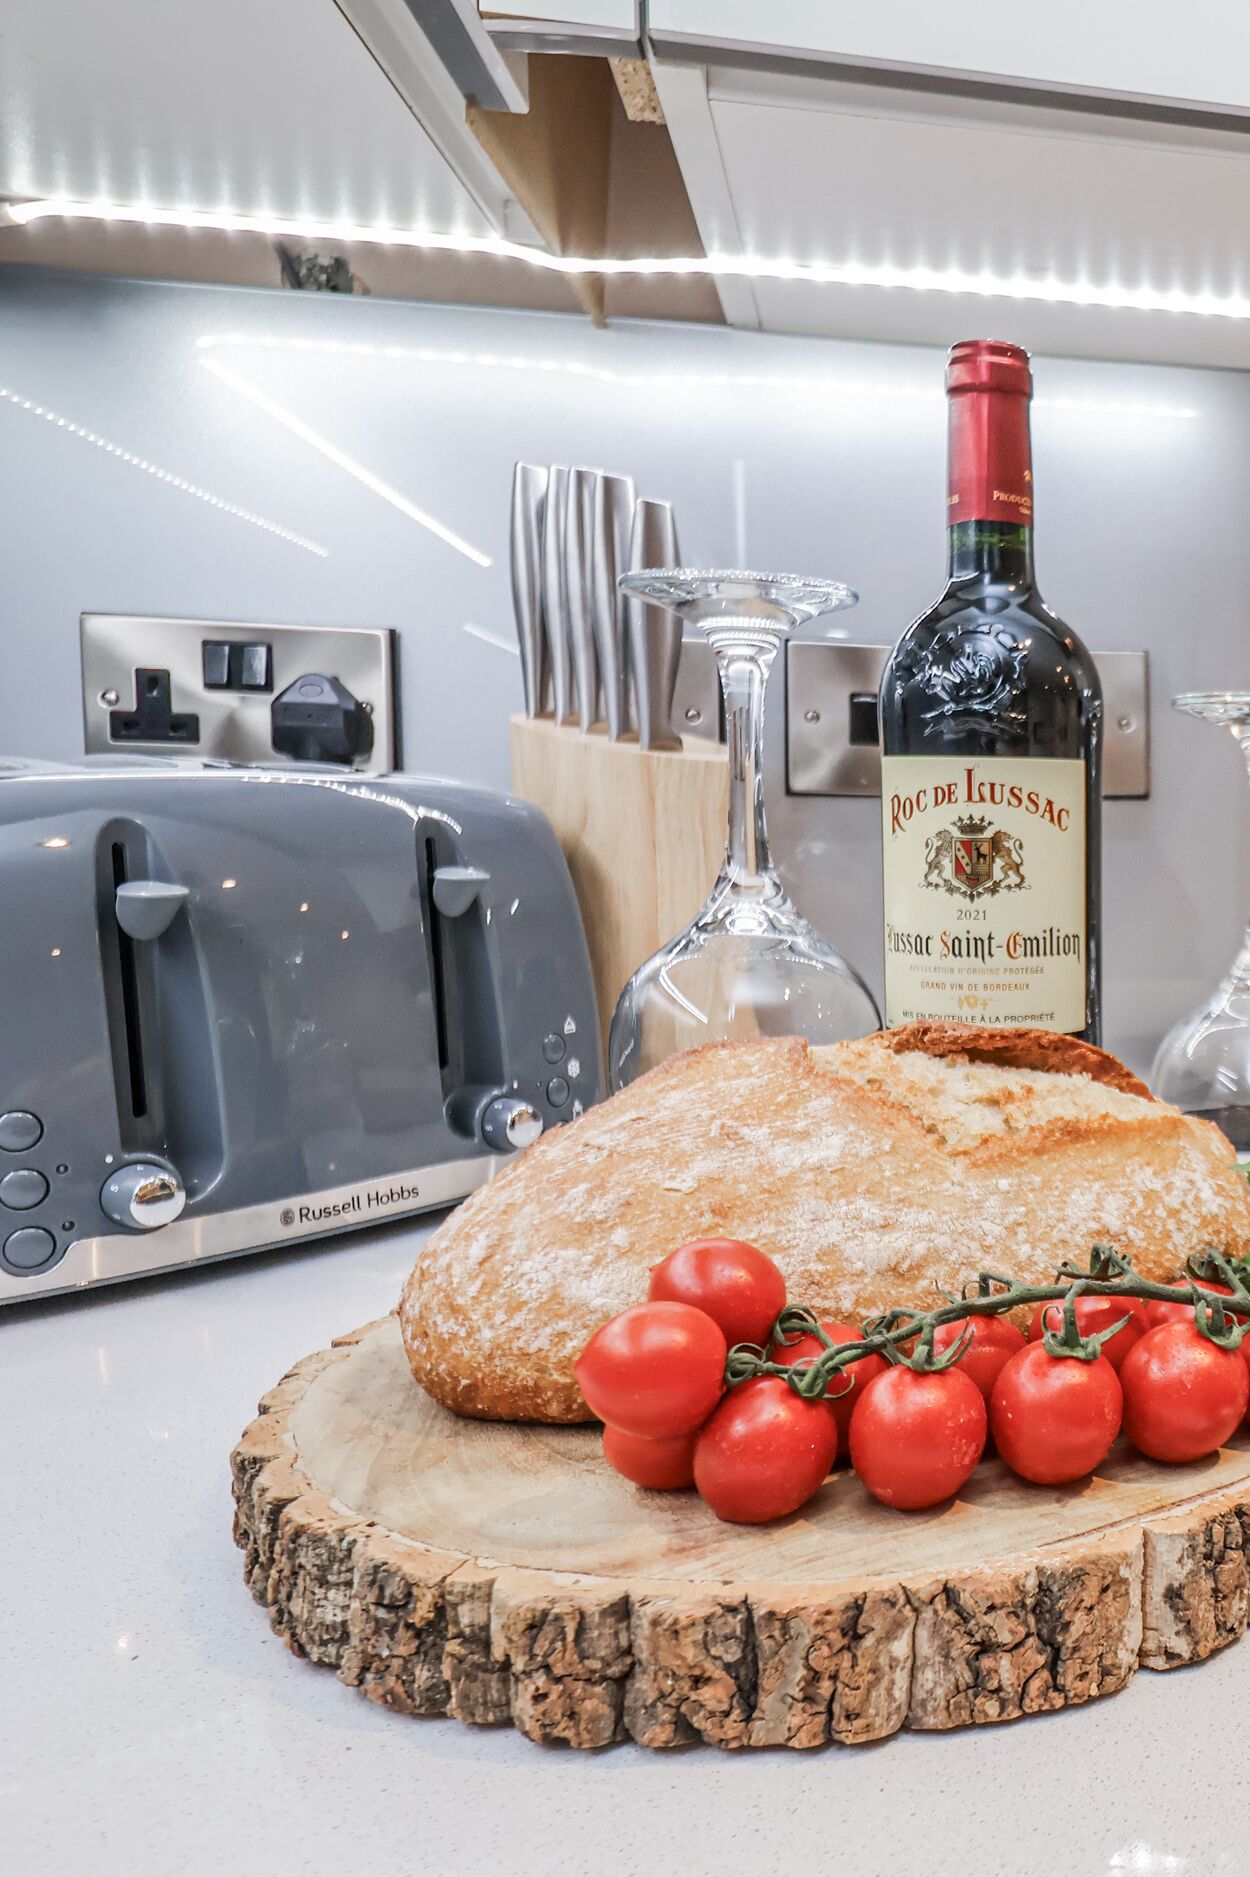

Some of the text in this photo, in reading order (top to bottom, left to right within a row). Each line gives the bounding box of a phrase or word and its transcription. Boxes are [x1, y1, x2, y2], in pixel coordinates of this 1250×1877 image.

[890, 767, 1070, 836] ROC DE LUSSAC
[956, 909, 987, 921] 2021
[939, 927, 1081, 964] Saint-Emilion
[1003, 965, 1045, 976] PROTÉGÉE
[920, 981, 1030, 992] GRAND VIN DE BORDEAUX
[902, 1010, 914, 1019] MIS
[915, 1012, 926, 1020] EN
[979, 1014, 987, 1024] À
[989, 1016, 1001, 1024] LA
[1004, 1012, 1055, 1024] PROPRIÉTÉ
[299, 1186, 419, 1223] Russell Hobbs
